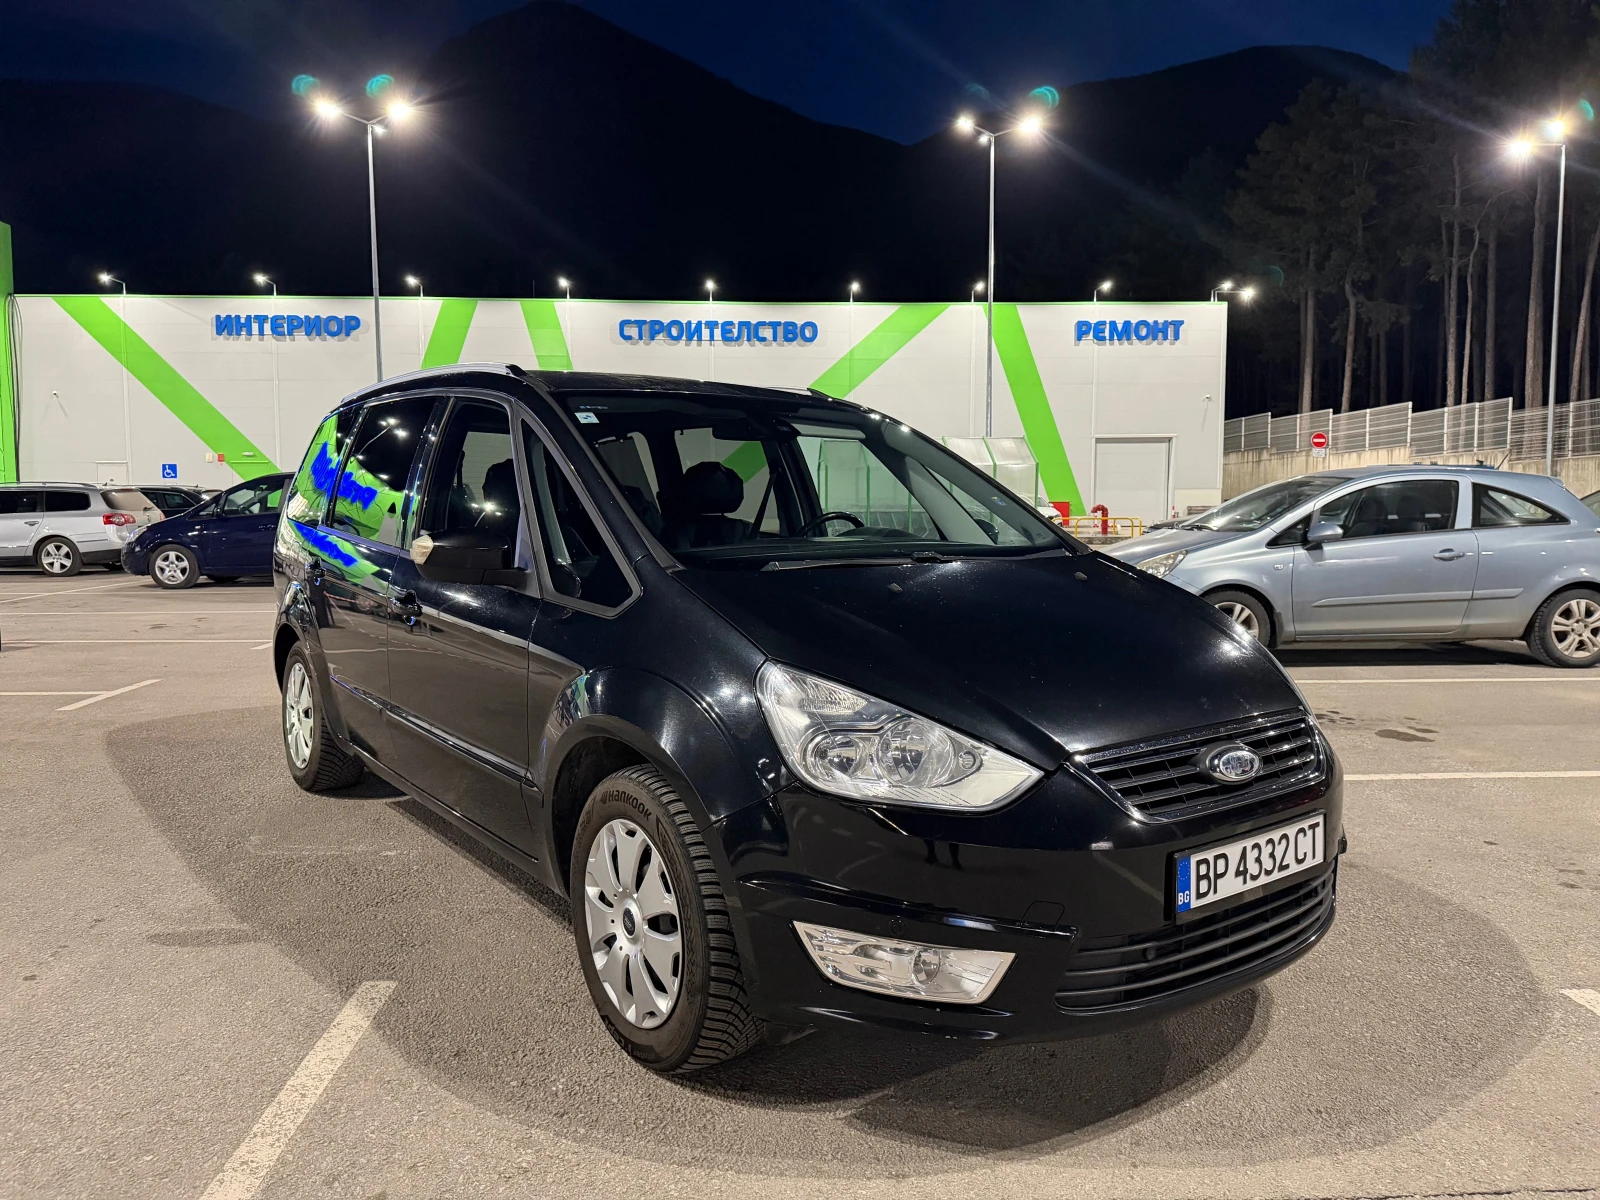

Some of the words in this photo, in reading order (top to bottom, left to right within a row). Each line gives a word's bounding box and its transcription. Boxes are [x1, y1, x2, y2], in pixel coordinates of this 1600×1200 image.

[215, 314, 361, 337] ИНТЕРИОР
[619, 319, 818, 343] СТРОИТЕЛСТВО
[1076, 319, 1185, 342] РЕМОНТ
[1195, 852, 1229, 901] BP
[1235, 832, 1290, 885] 4332
[1294, 821, 1320, 865] CT
[1178, 890, 1190, 905] BG
